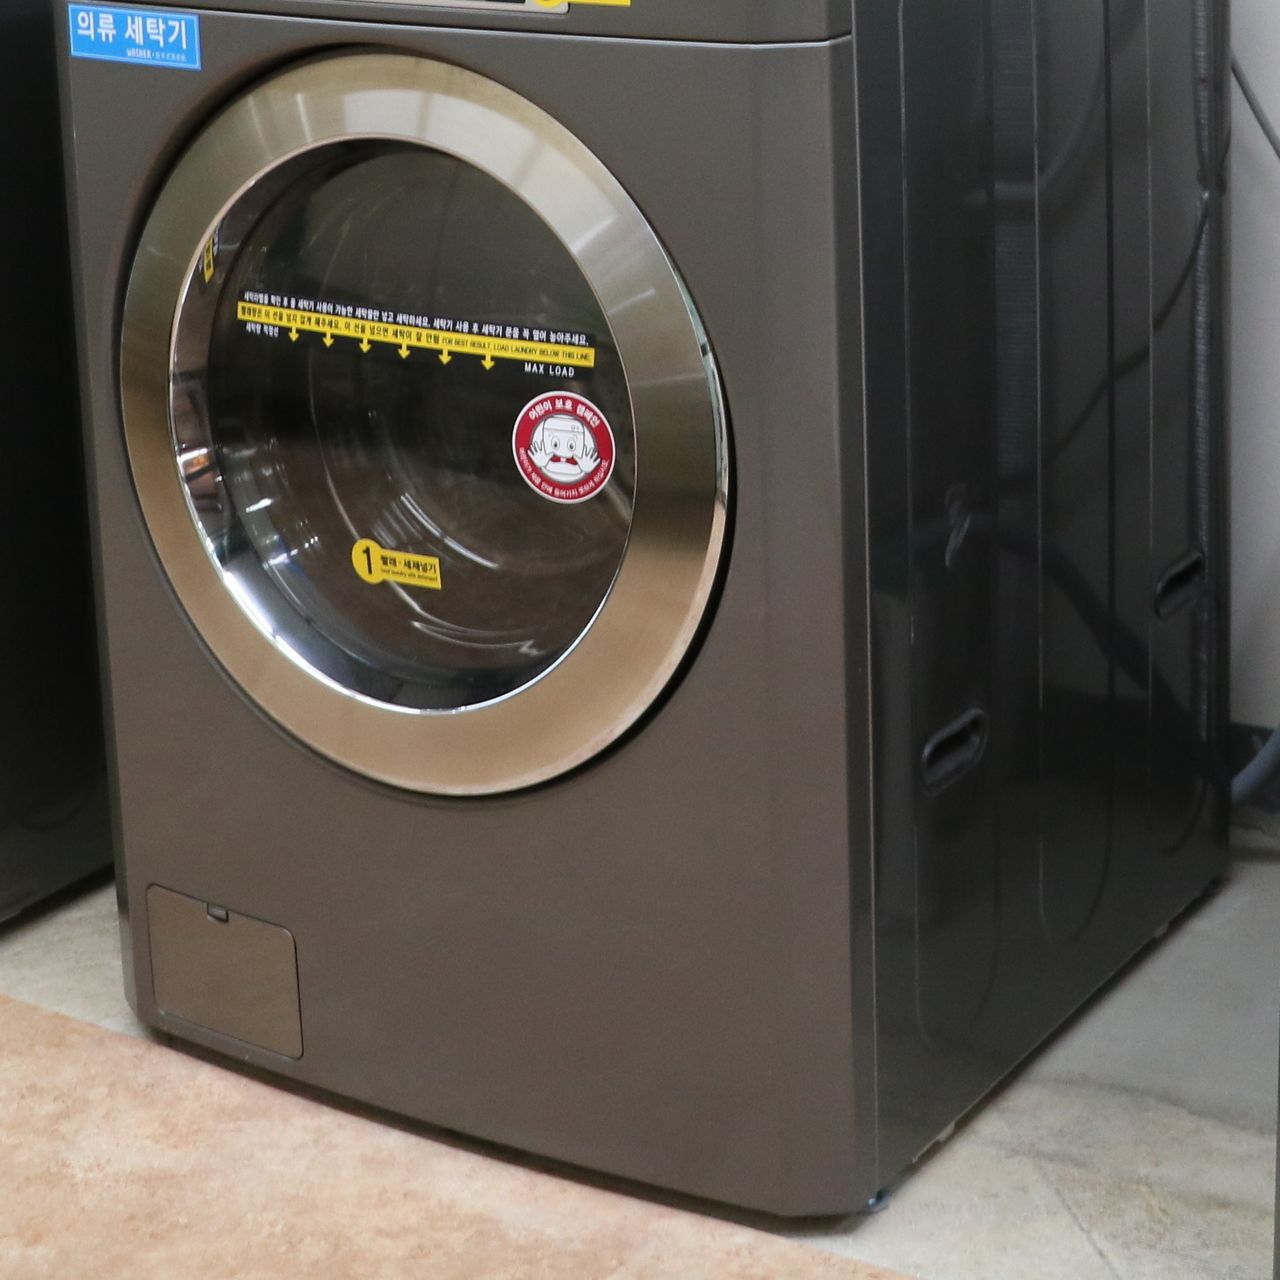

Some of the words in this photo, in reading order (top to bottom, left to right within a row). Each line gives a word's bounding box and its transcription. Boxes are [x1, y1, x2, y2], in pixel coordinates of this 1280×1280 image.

[78, 12, 116, 43] 의류
[125, 16, 186, 49] 세탁기
[525, 362, 544, 374] MAX
[549, 366, 575, 377] LOAD
[363, 546, 372, 574] 1
